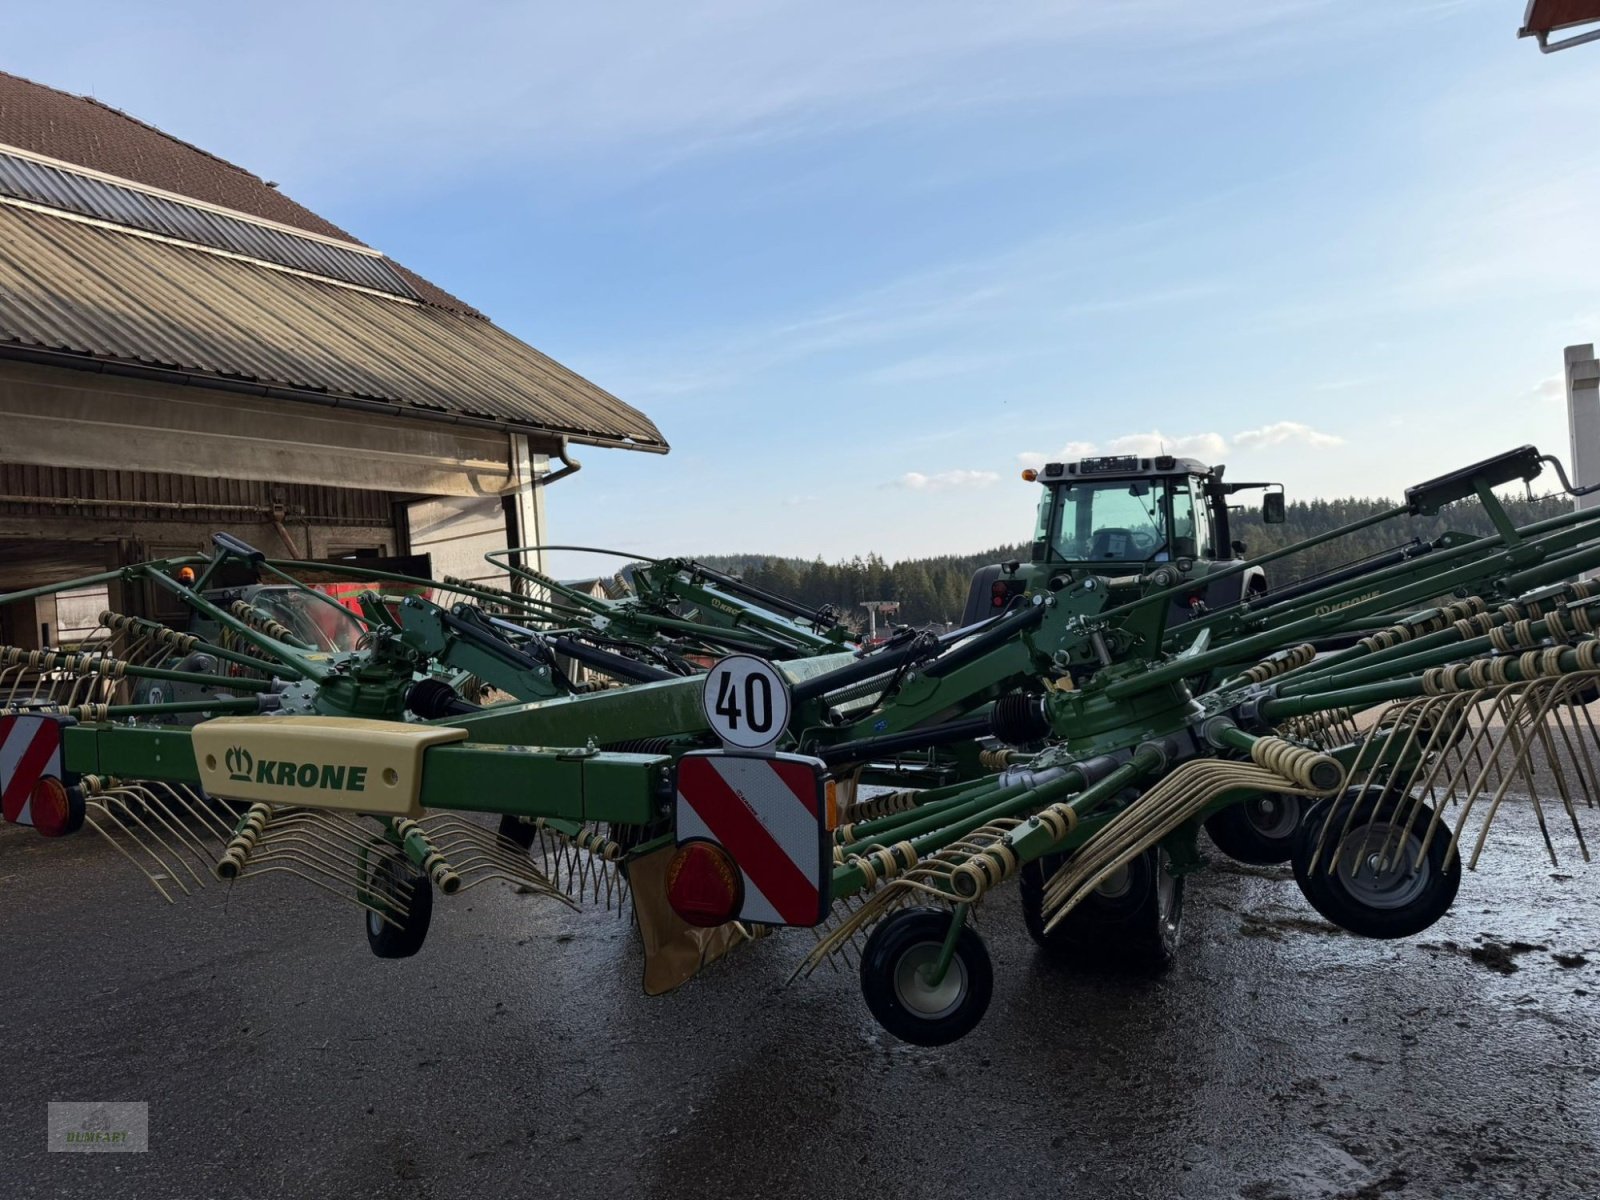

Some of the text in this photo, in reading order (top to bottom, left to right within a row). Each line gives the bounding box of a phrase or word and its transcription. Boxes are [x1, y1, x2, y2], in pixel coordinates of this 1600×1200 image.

[719, 603, 741, 617] KRO
[715, 671, 773, 733] 40
[256, 759, 368, 792] KRONE
